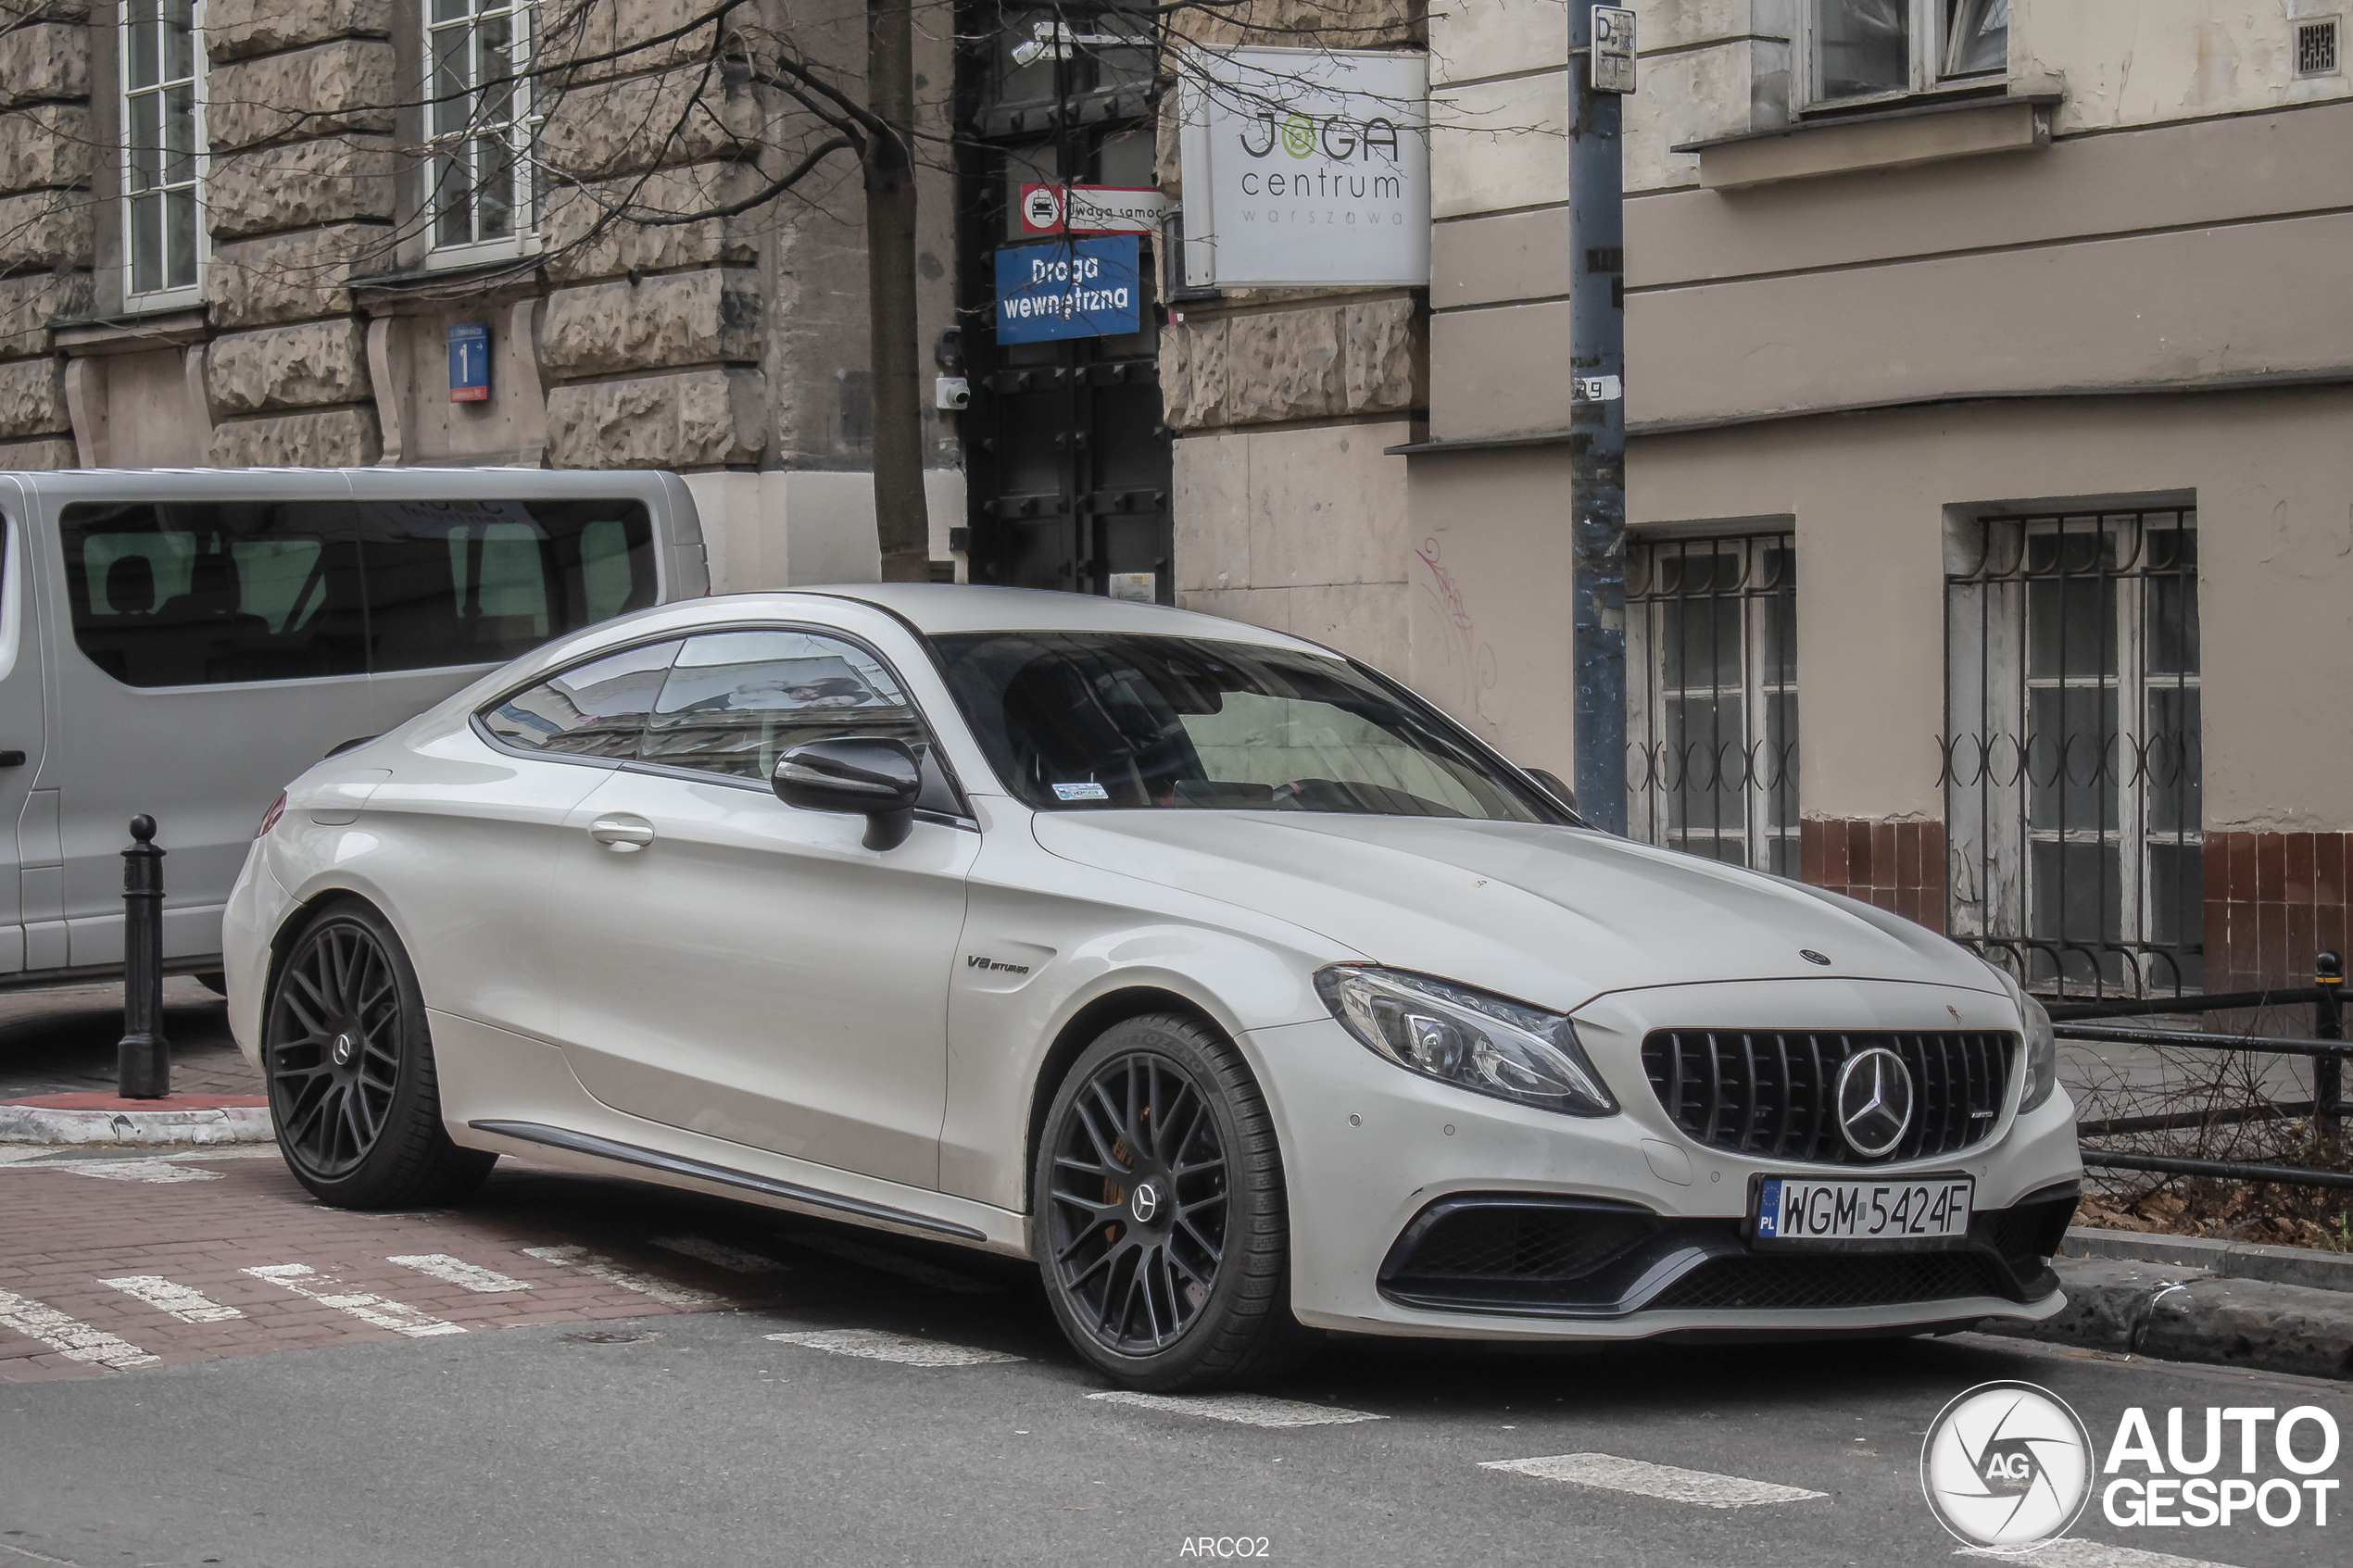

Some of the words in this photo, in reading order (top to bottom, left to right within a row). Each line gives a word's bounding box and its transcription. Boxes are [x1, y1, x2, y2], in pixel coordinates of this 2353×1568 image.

[1241, 167, 1400, 199] centrum
[1242, 210, 1403, 225] warszawa
[1032, 257, 1099, 286] Droga
[1004, 287, 1128, 320] wewnętrzna
[459, 343, 469, 383] 1
[967, 955, 991, 969] V8
[990, 961, 1030, 974] BITURBO
[1760, 1216, 1775, 1231] PL
[1783, 1185, 1859, 1235] WGM
[1868, 1185, 1969, 1235] 5424F
